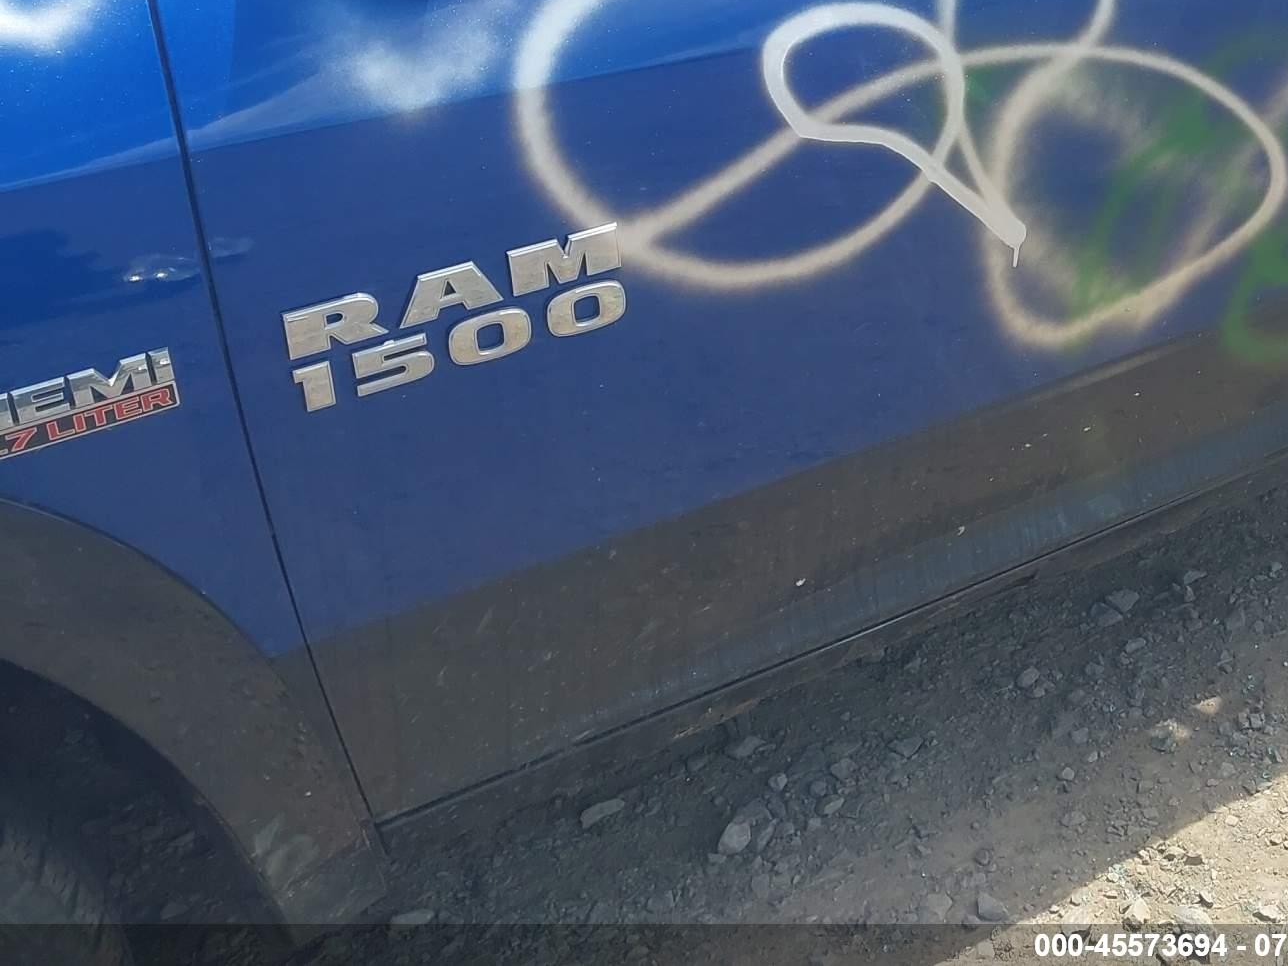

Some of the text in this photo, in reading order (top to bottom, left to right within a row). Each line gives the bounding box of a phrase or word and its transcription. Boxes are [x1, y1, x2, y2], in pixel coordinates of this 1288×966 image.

[282, 221, 622, 361] RAM
[292, 280, 627, 413] 1500
[46, 385, 173, 441] LITER
